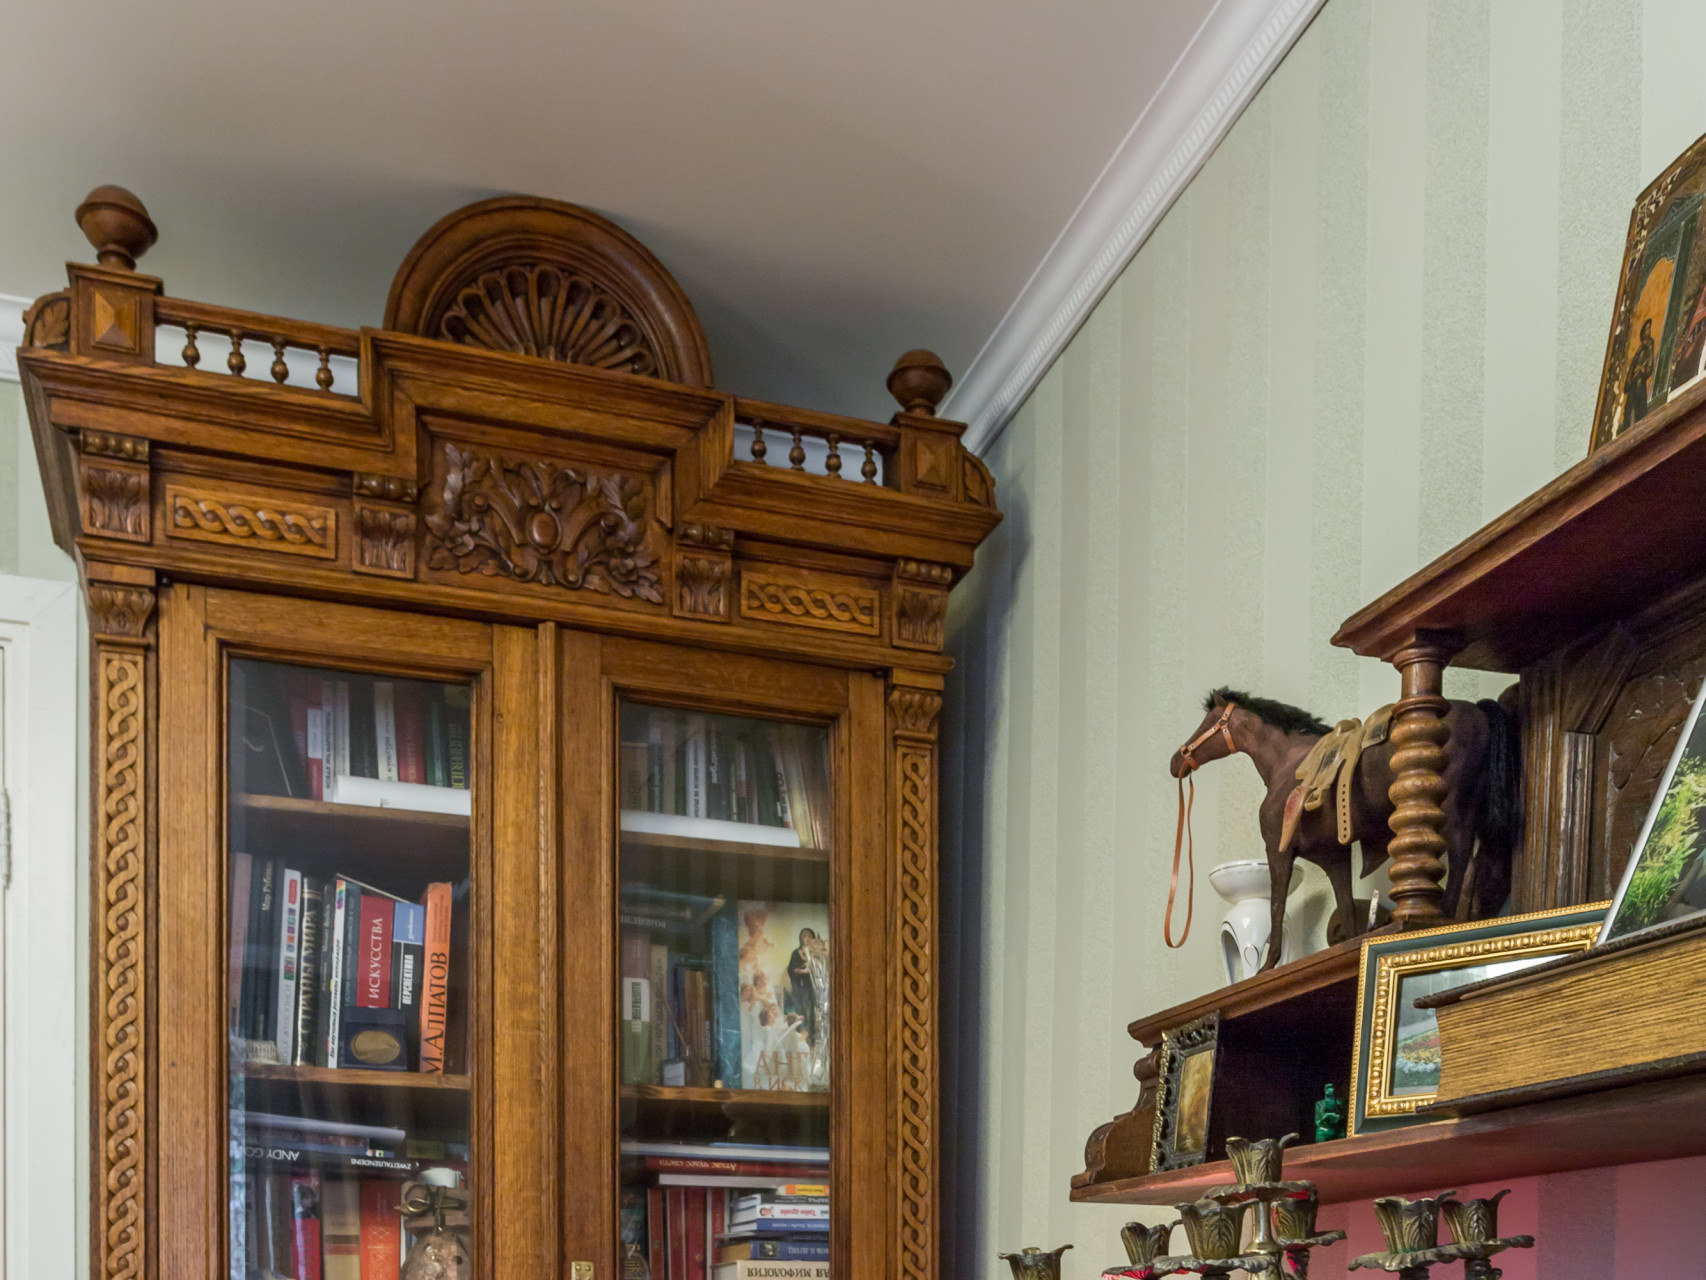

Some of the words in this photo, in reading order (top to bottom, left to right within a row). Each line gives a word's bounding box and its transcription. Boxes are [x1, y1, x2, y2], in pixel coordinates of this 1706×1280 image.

[303, 910, 317, 958] МИРА
[368, 917, 384, 999] ИСКУССТВА
[266, 1149, 300, 1161] ANDY
[350, 1158, 412, 1170] ZWEITAUSENDEINS
[747, 1267, 812, 1278] МИФОЛОГИЯ
